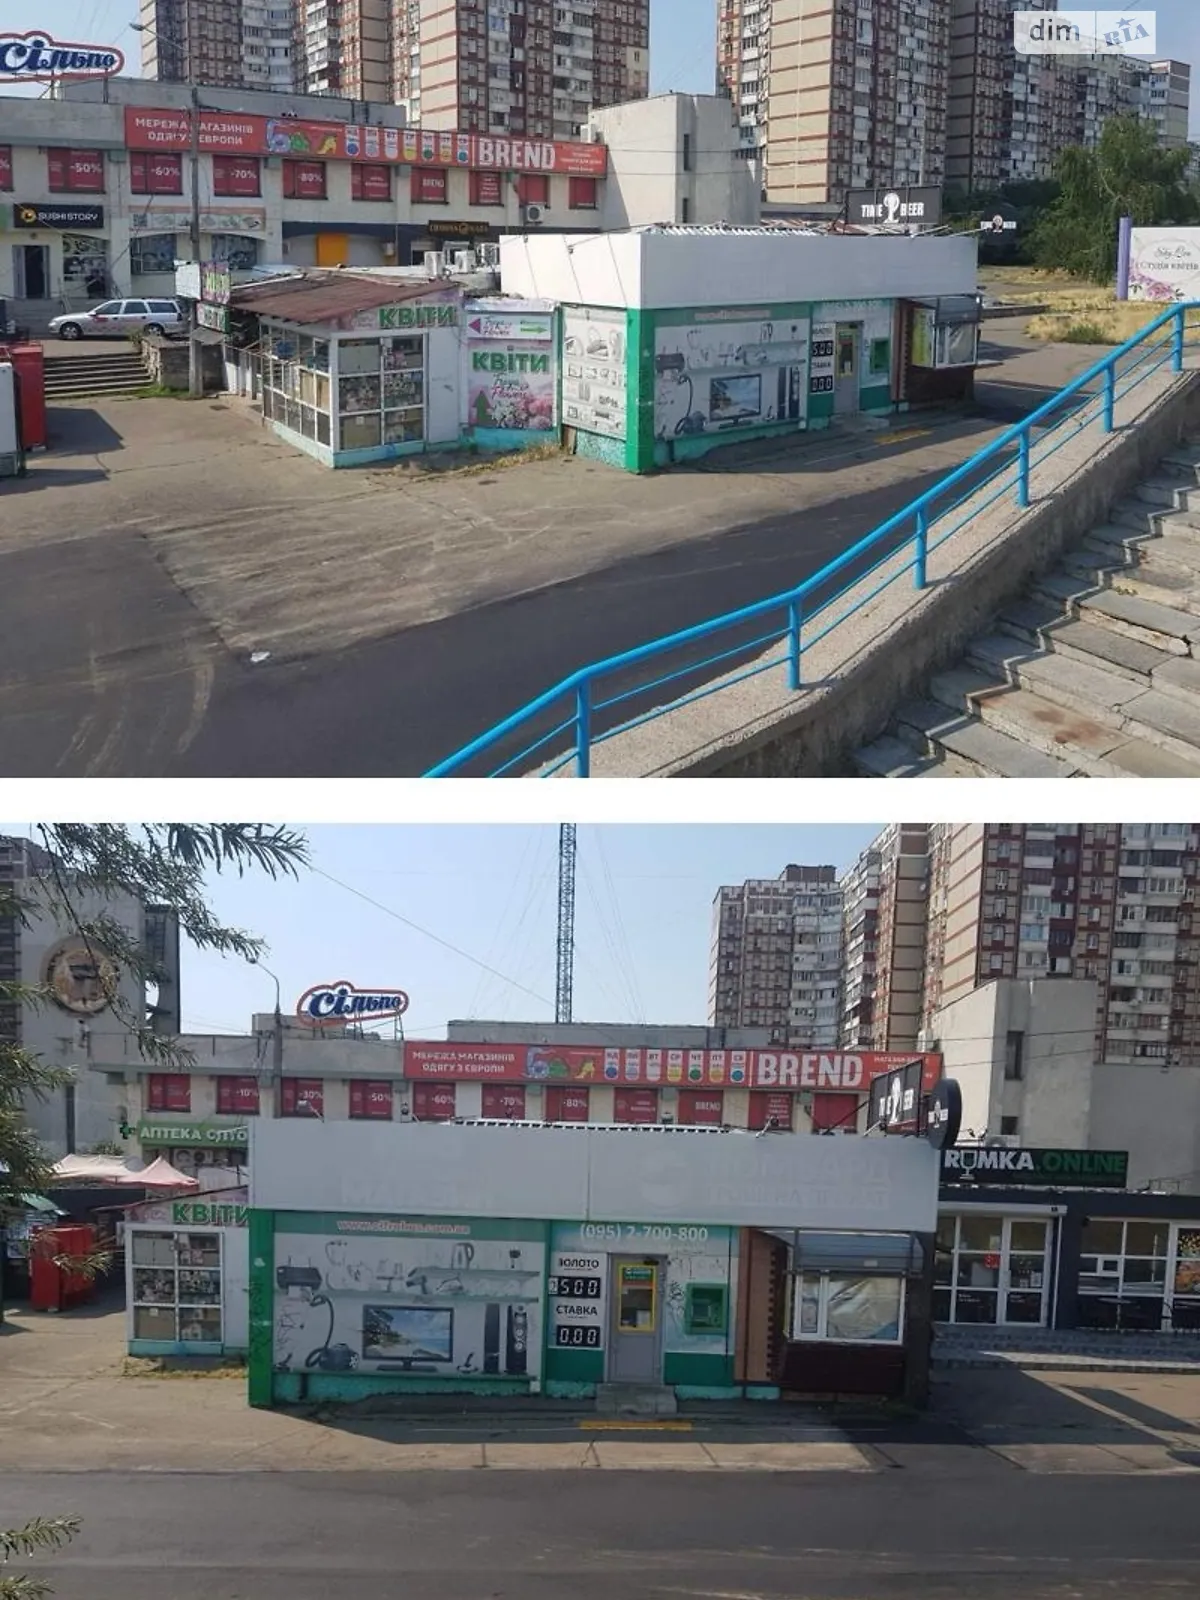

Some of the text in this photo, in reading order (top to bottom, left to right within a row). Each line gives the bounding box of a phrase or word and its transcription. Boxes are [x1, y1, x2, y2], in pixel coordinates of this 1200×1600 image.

[0, 40, 115, 72] Сільпо
[135, 118, 253, 134] МЕРЕЖА АГАЗИНІВ
[480, 138, 556, 170] BREND
[70, 162, 102, 174] -50%
[151, 167, 181, 176] -60%
[230, 169, 258, 179] -70%
[900, 202, 925, 216] BEER
[378, 299, 457, 329] КВІТИ
[472, 345, 549, 373] КВІТИ
[309, 988, 401, 1018] Сільпо
[413, 1051, 515, 1061] МЕРЕЖА МАГАЗИНІВ
[422, 1064, 455, 1073] ОДЯГУ
[465, 1064, 505, 1073] ЄВРОПИ
[757, 1053, 863, 1087] BREND
[140, 1127, 202, 1141] АПТЕКА
[580, 1223, 709, 1242] (095) 2-700-800
[559, 1257, 600, 1269] ЗОЛОТО
[556, 1305, 598, 1316] СТАВКА
[560, 1327, 597, 1345] 0.00
